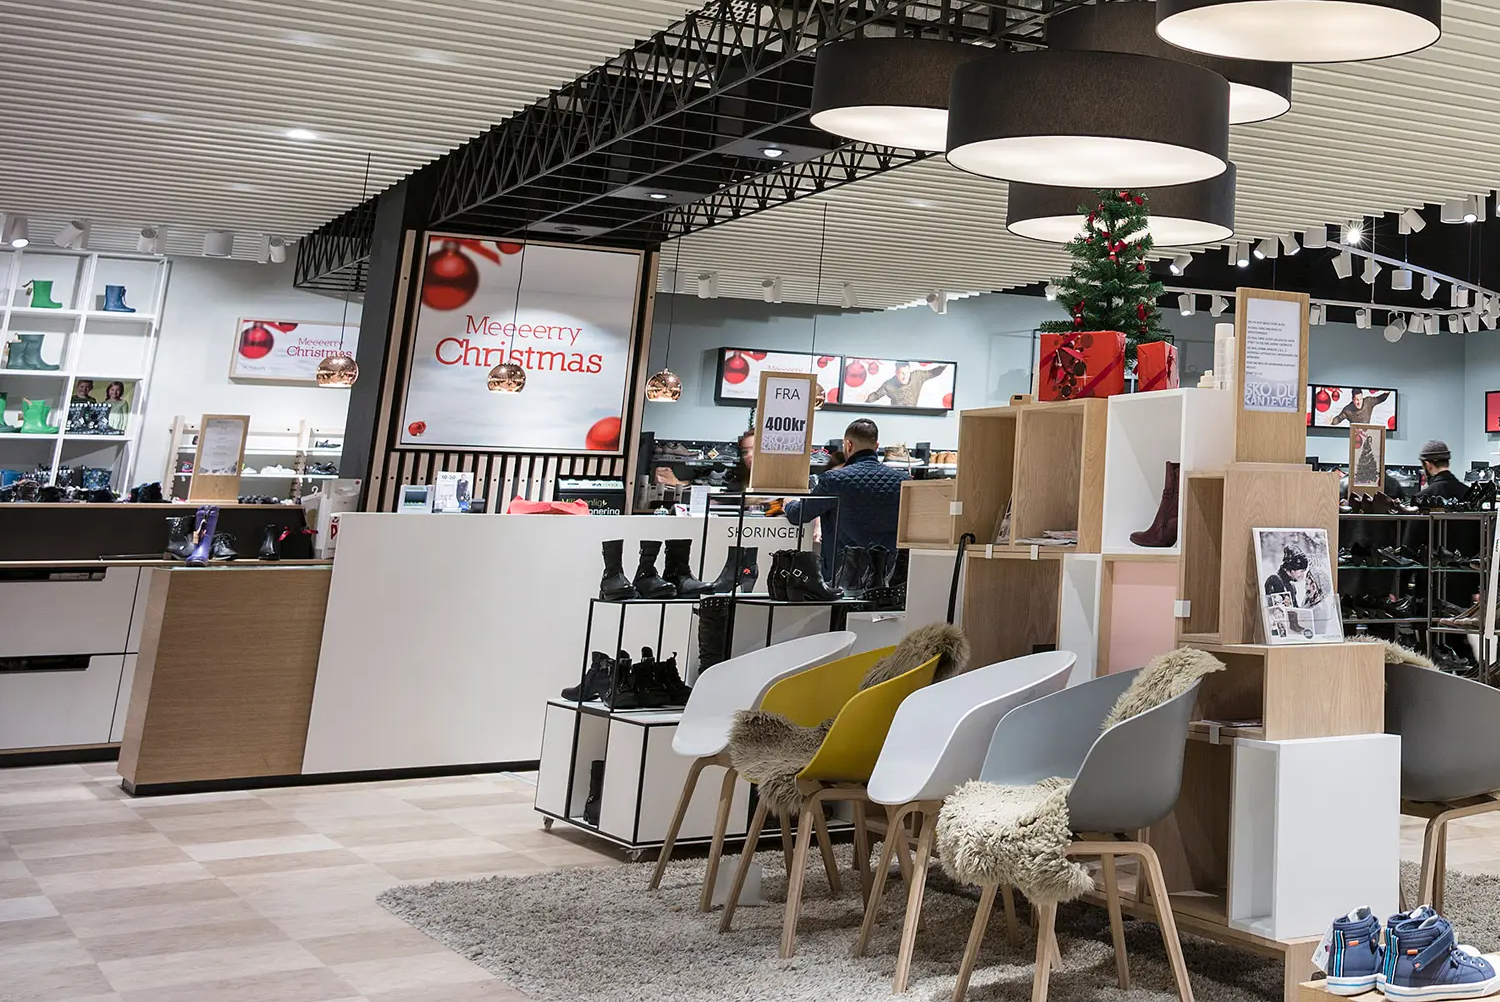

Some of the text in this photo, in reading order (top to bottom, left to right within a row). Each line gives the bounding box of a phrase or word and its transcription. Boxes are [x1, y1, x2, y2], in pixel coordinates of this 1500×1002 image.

[466, 315, 582, 346] Meeeerry
[435, 337, 603, 374] Christmas
[775, 387, 800, 400] FRA
[1245, 381, 1298, 398] SKO DU
[765, 416, 805, 432] 400kr
